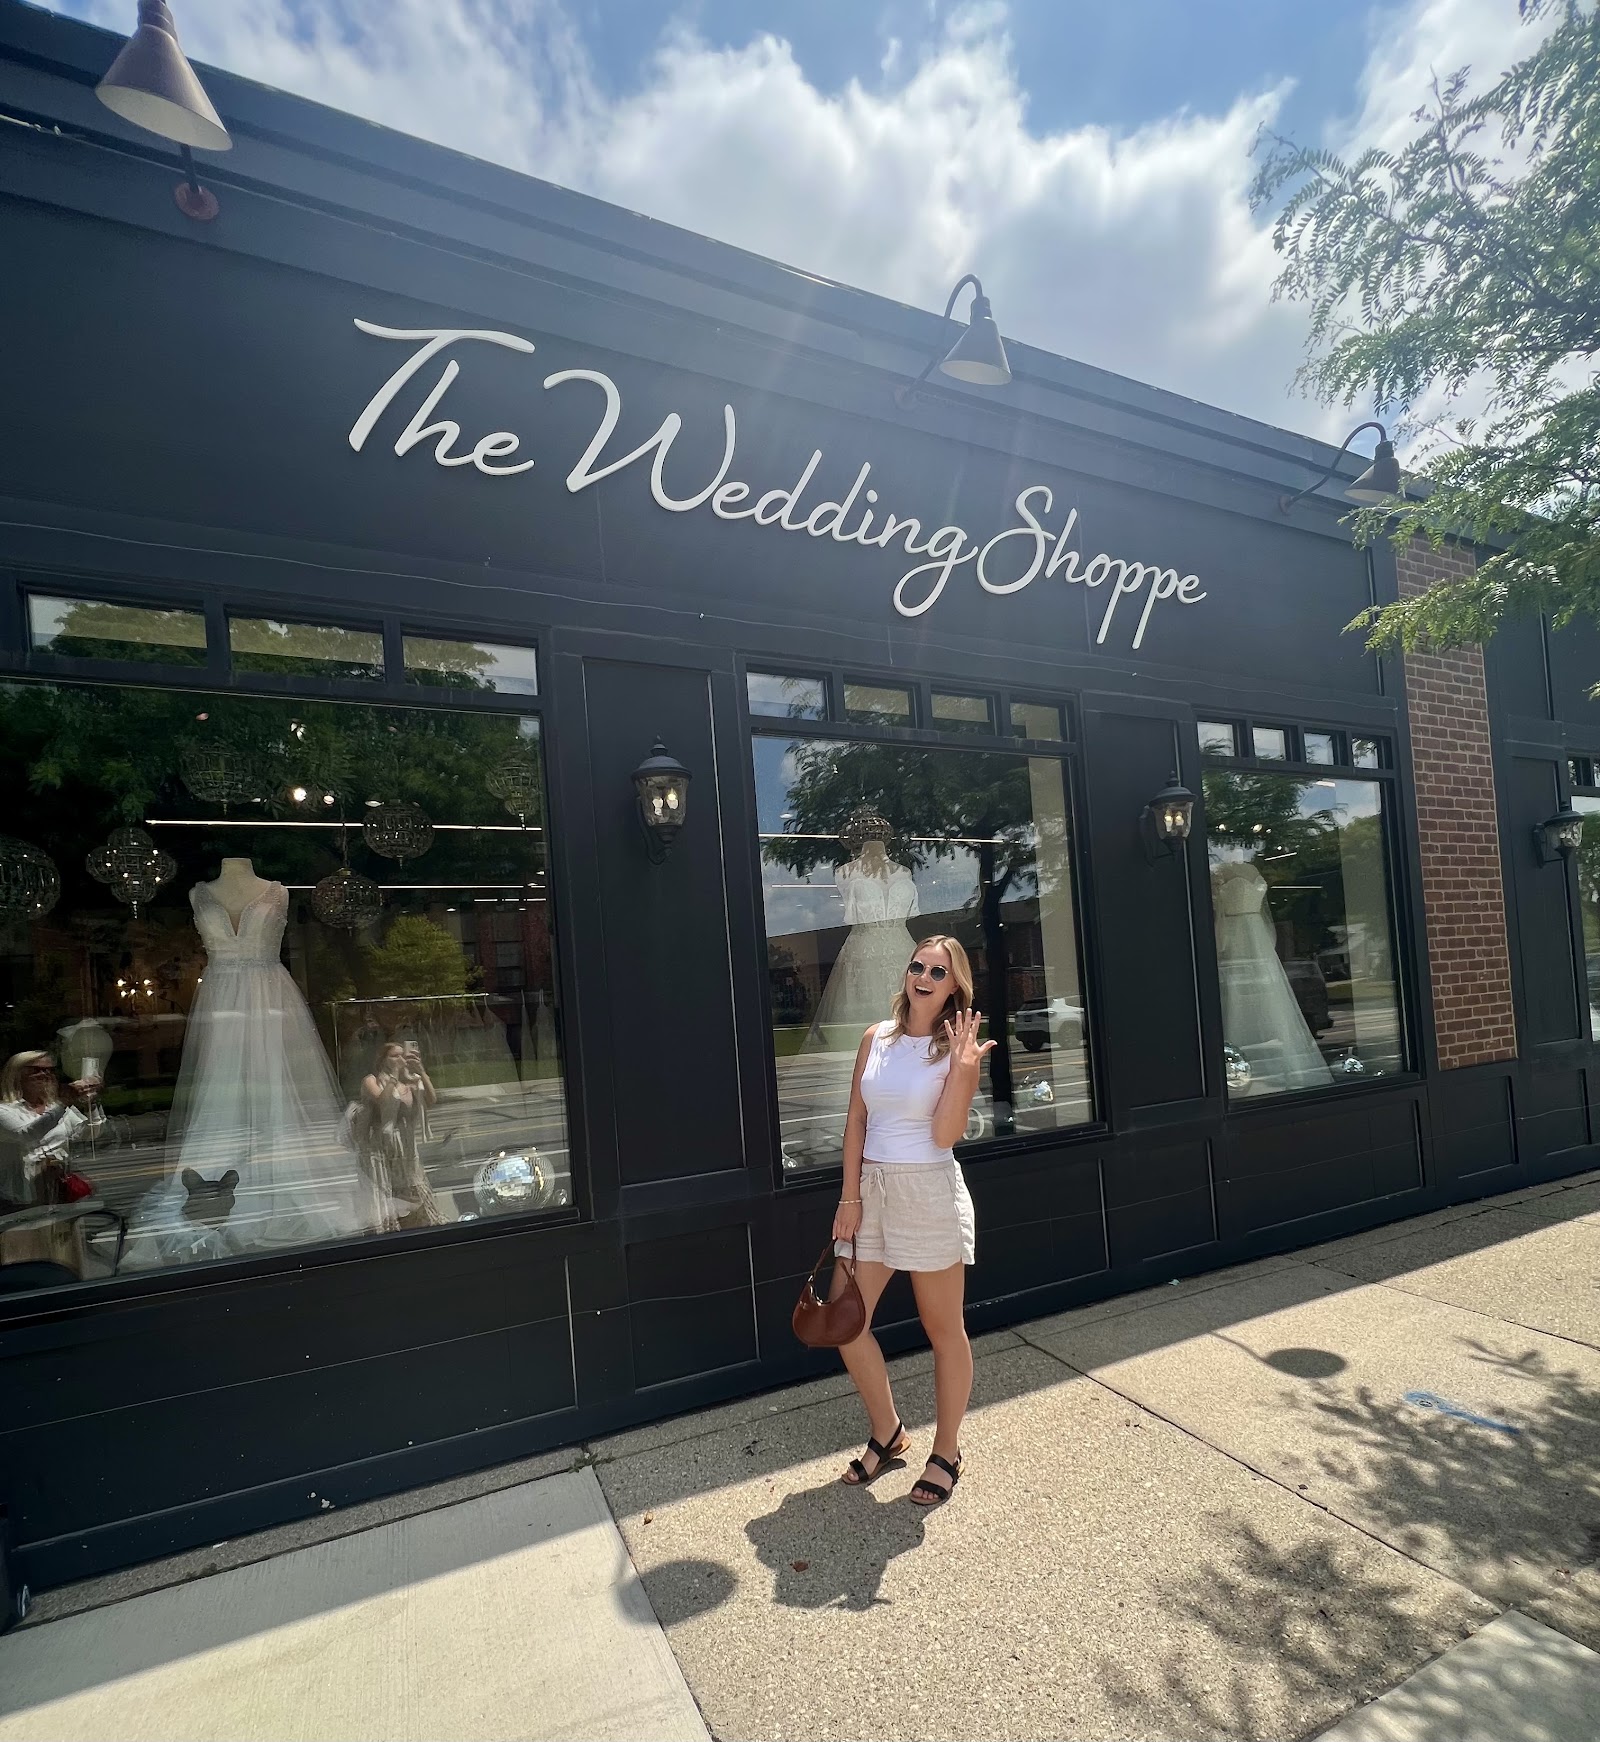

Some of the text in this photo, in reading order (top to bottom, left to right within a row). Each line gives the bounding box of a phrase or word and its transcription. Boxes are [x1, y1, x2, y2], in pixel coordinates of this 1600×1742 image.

[348, 318, 1207, 650] The Wedding Shoppe
